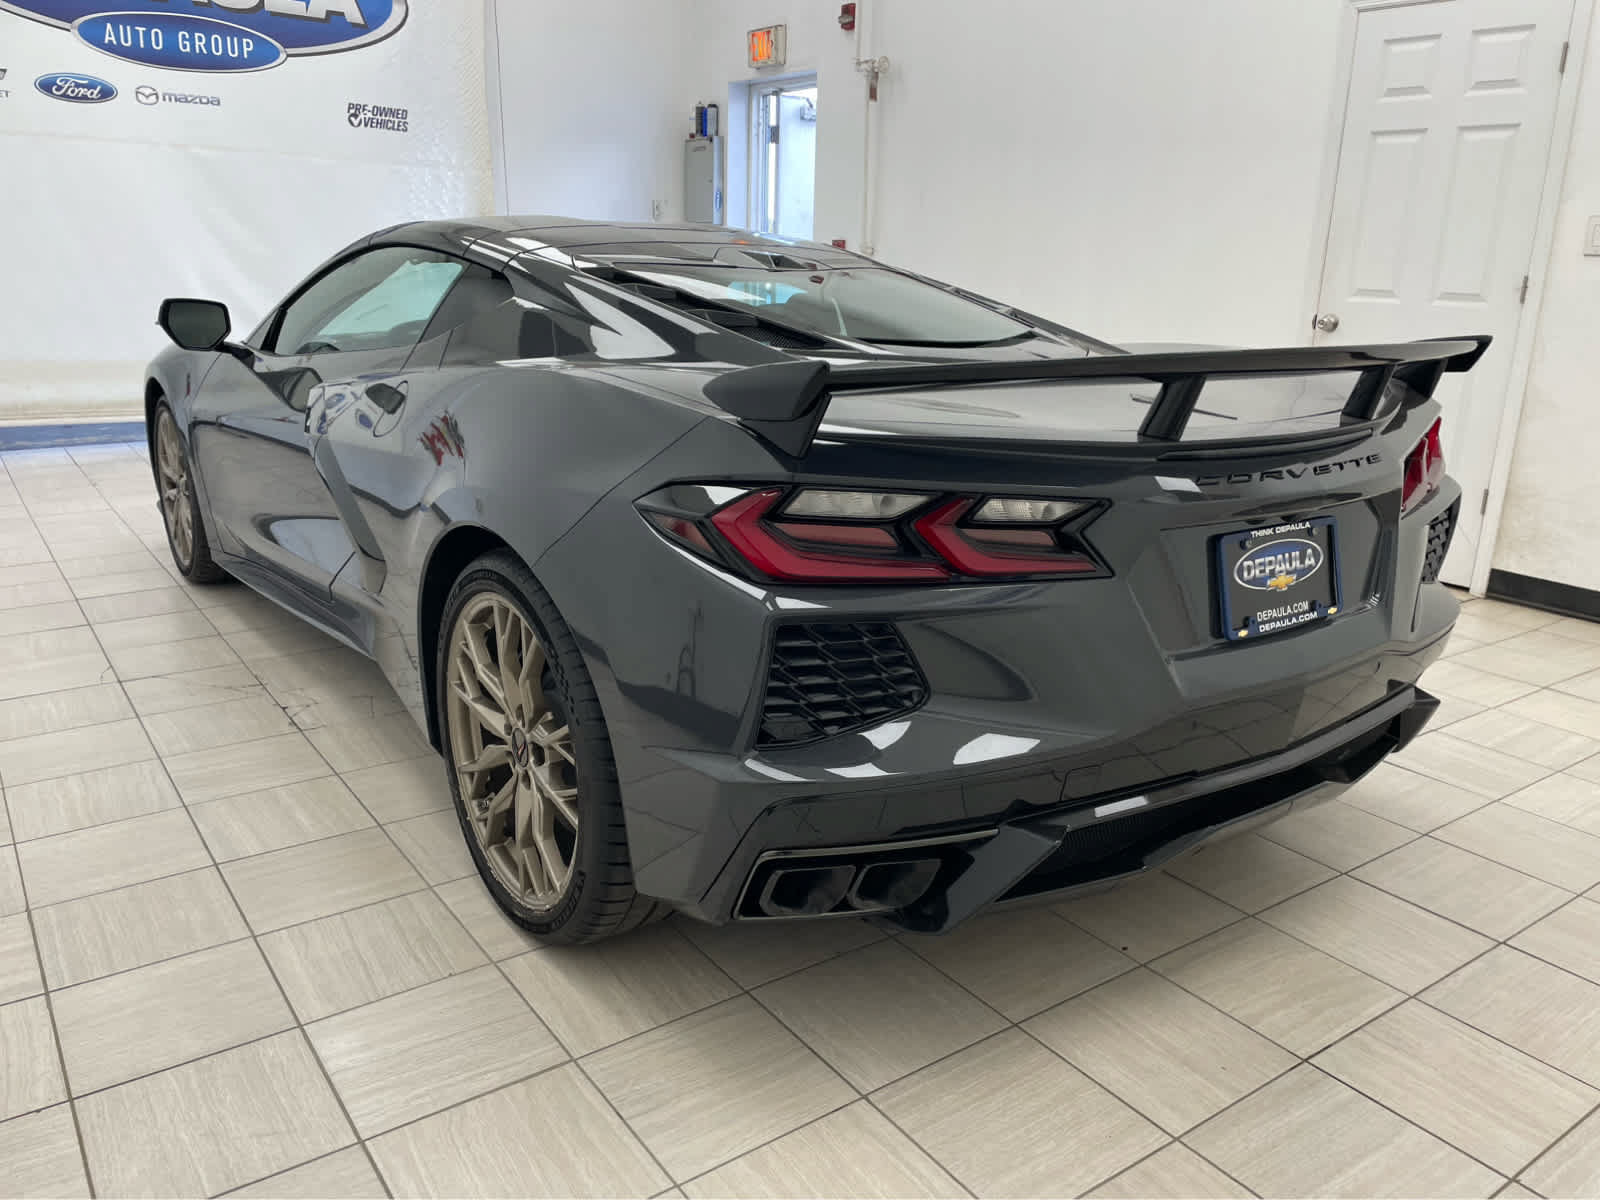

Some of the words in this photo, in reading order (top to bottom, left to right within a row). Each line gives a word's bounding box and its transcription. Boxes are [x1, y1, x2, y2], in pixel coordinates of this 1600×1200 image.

[103, 22, 164, 50] AUTO
[178, 31, 254, 59] GROUP
[52, 76, 102, 99] Ford
[162, 92, 221, 106] mazda
[347, 102, 408, 120] PRE-OWNED
[363, 116, 409, 132] VEHICLES
[1195, 453, 1382, 487] CORVETTE
[1251, 528, 1274, 538] THINK
[1275, 521, 1311, 534] DEPAULA
[1242, 548, 1316, 581] DEPAULA
[1257, 600, 1309, 622] DEPAULA.COM
[1259, 611, 1318, 633] DEPAULA.COM
